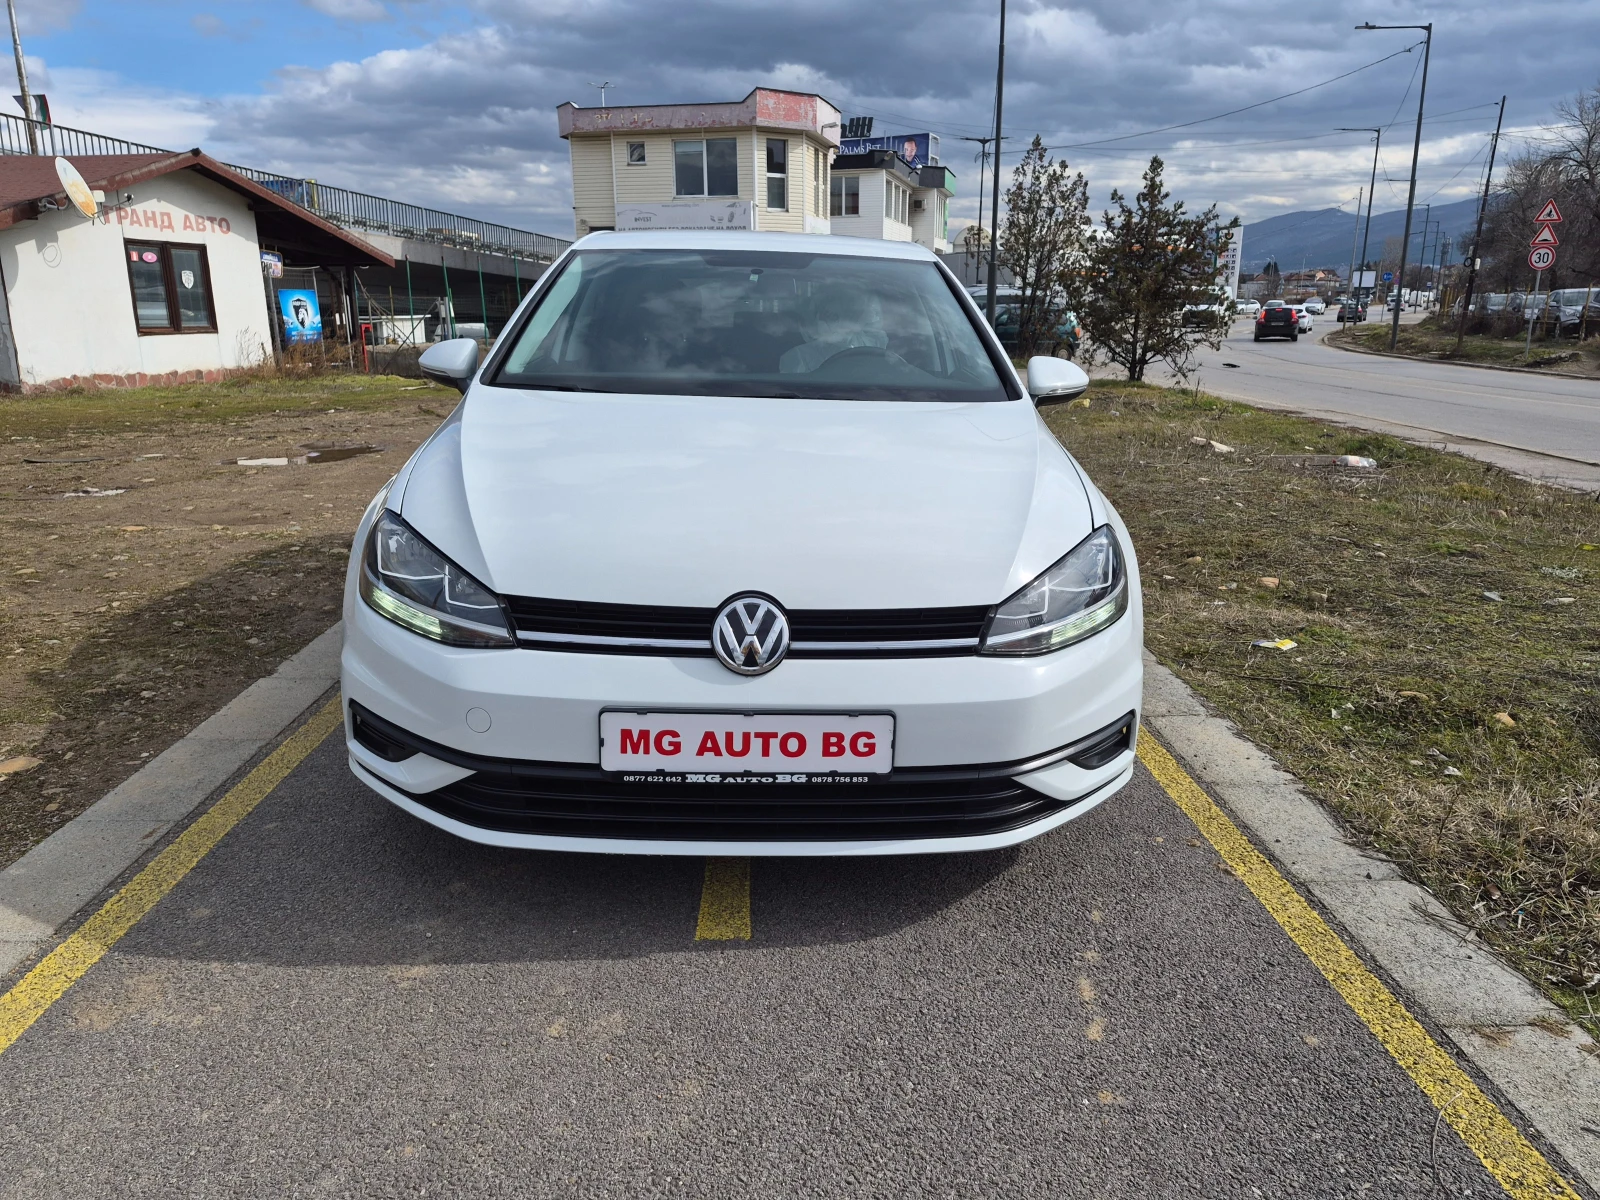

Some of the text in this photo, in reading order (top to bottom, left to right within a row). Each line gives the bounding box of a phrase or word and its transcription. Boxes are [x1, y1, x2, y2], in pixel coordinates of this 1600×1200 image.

[839, 144, 865, 155] PALMS
[103, 204, 231, 235] ГРАНД АВТО
[1533, 251, 1550, 264] 30
[619, 728, 877, 758] MG AUTO BG
[623, 775, 646, 783] 0877
[647, 775, 664, 783] 622
[665, 776, 682, 784] 642
[685, 774, 722, 783] MG
[775, 774, 808, 783] BG
[811, 776, 833, 784] 0878
[834, 776, 851, 784] 756
[852, 776, 869, 784] 853
